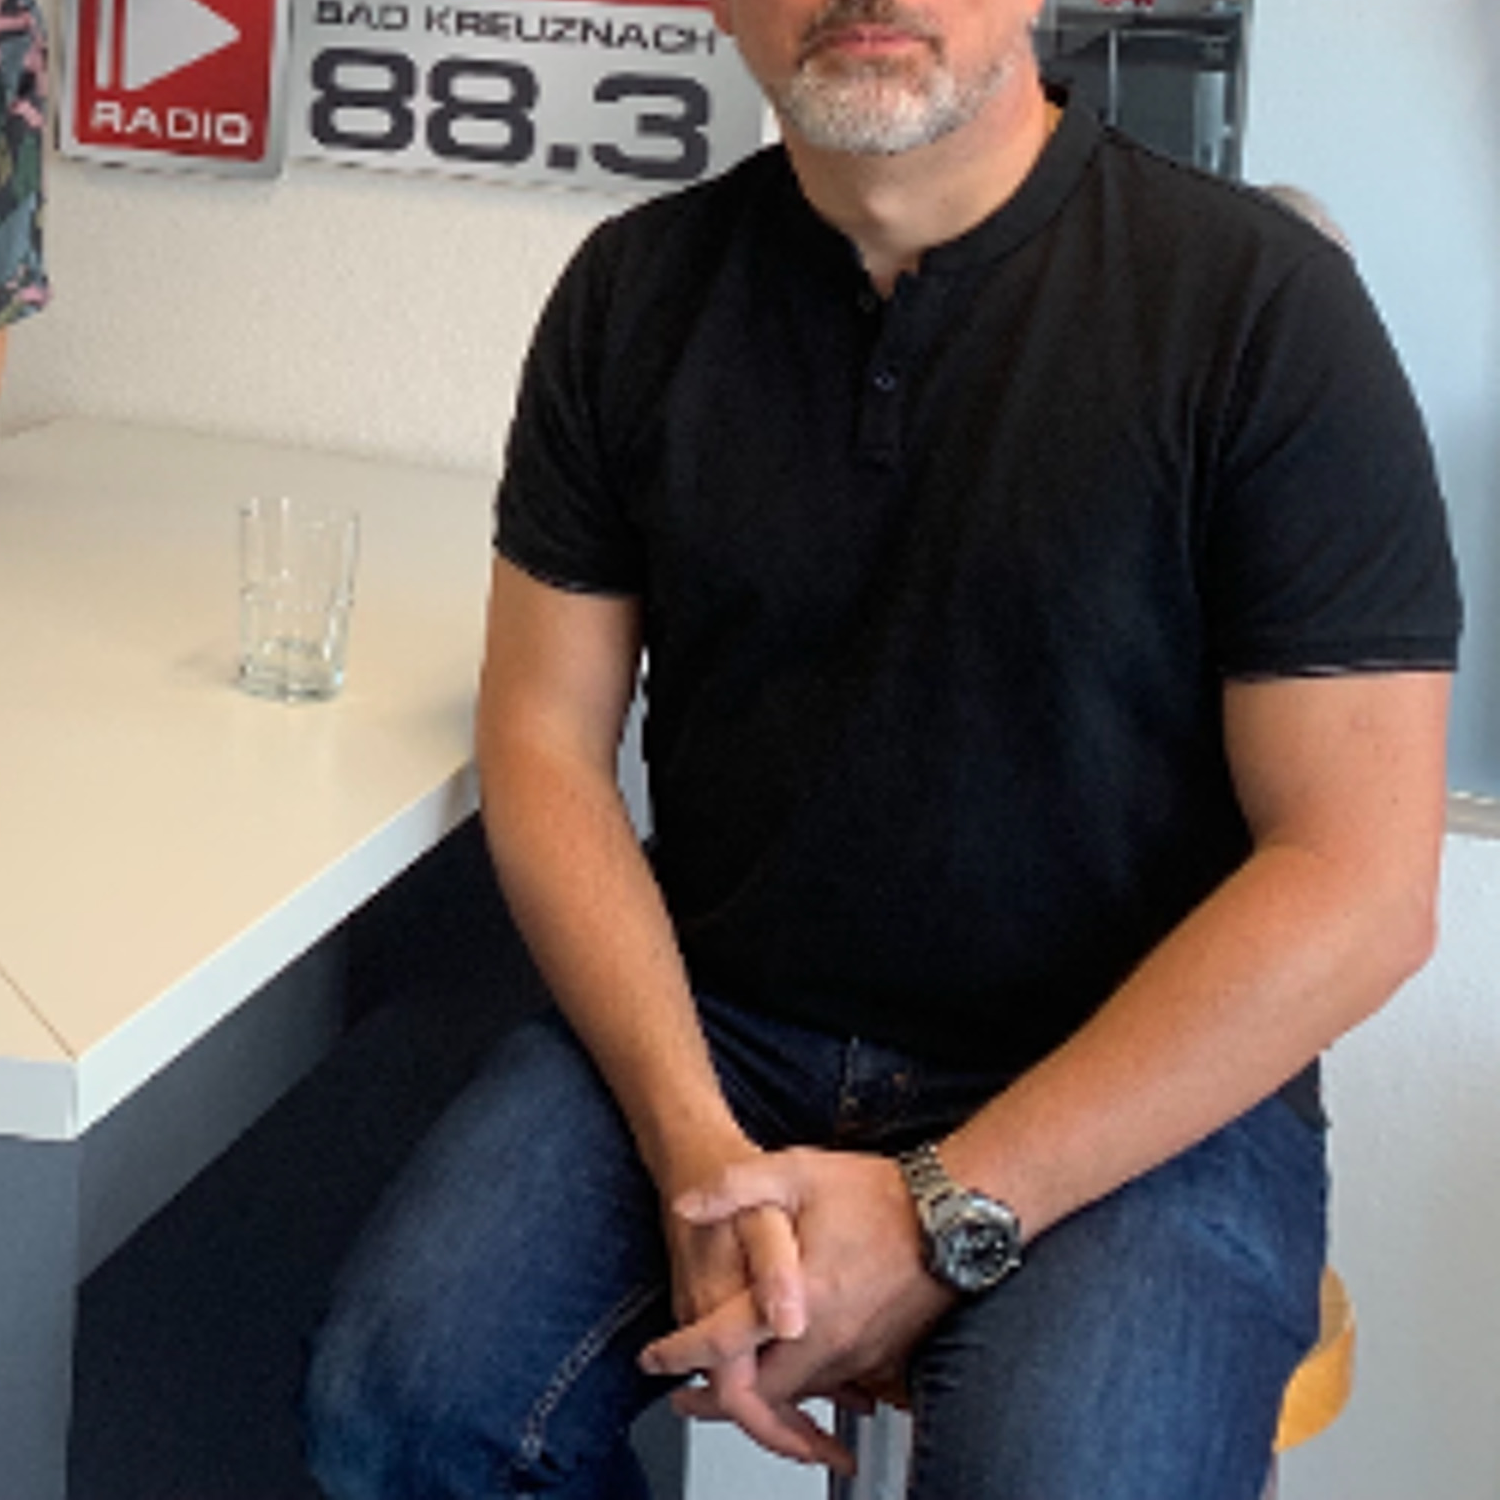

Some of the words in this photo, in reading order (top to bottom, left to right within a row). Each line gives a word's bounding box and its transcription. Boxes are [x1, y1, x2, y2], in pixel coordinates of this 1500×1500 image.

[313, 0, 410, 32] BAD
[424, 4, 716, 55] KREUZNACH
[90, 102, 253, 145] RADIO
[308, 48, 710, 181] 88.3
